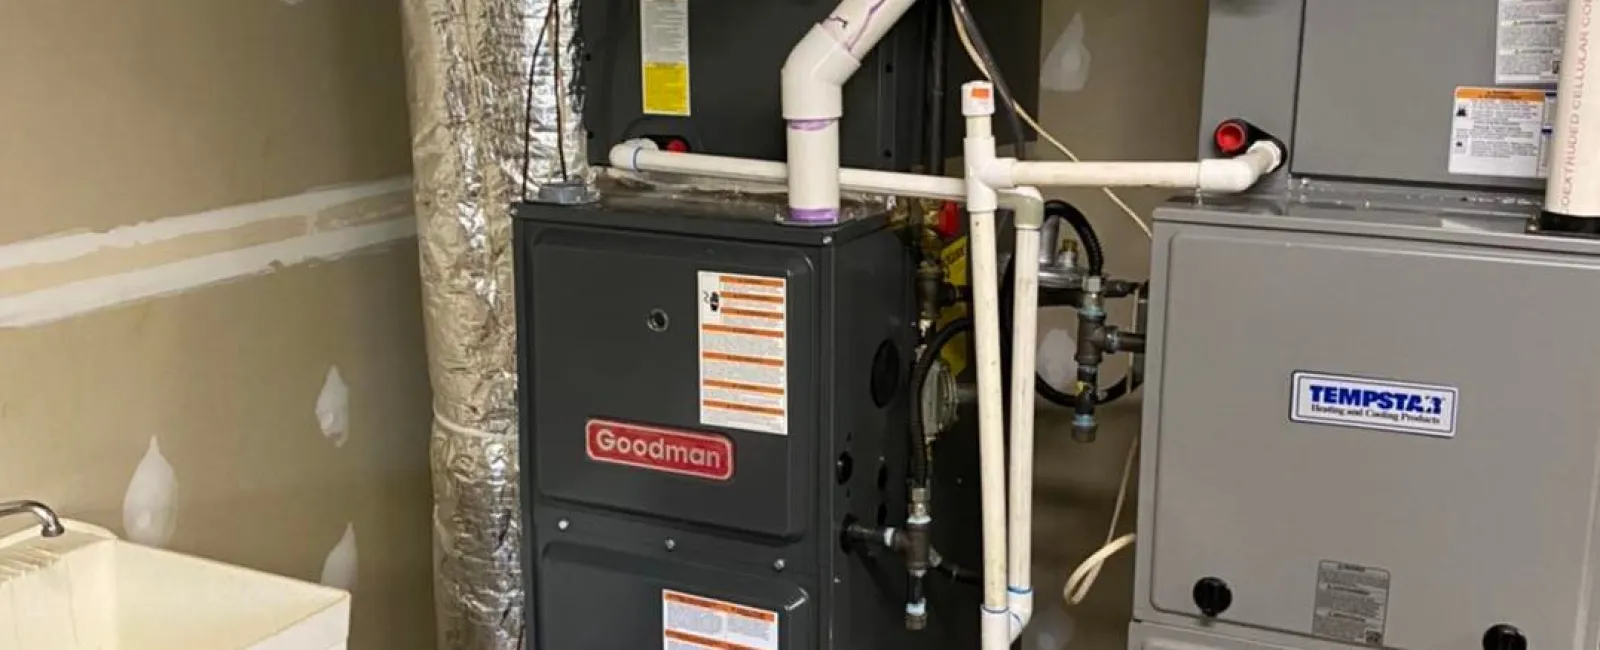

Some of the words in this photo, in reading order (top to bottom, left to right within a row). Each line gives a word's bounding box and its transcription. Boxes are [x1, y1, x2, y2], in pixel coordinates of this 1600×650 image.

[1571, 31, 1590, 111] CELLULAR
[1309, 385, 1442, 415] TEMPSTAR
[1311, 404, 1344, 417] Heating
[1347, 408, 1363, 417] and
[1366, 410, 1399, 422] Cooling
[1401, 412, 1441, 424] Products
[596, 428, 720, 469] Goodman
